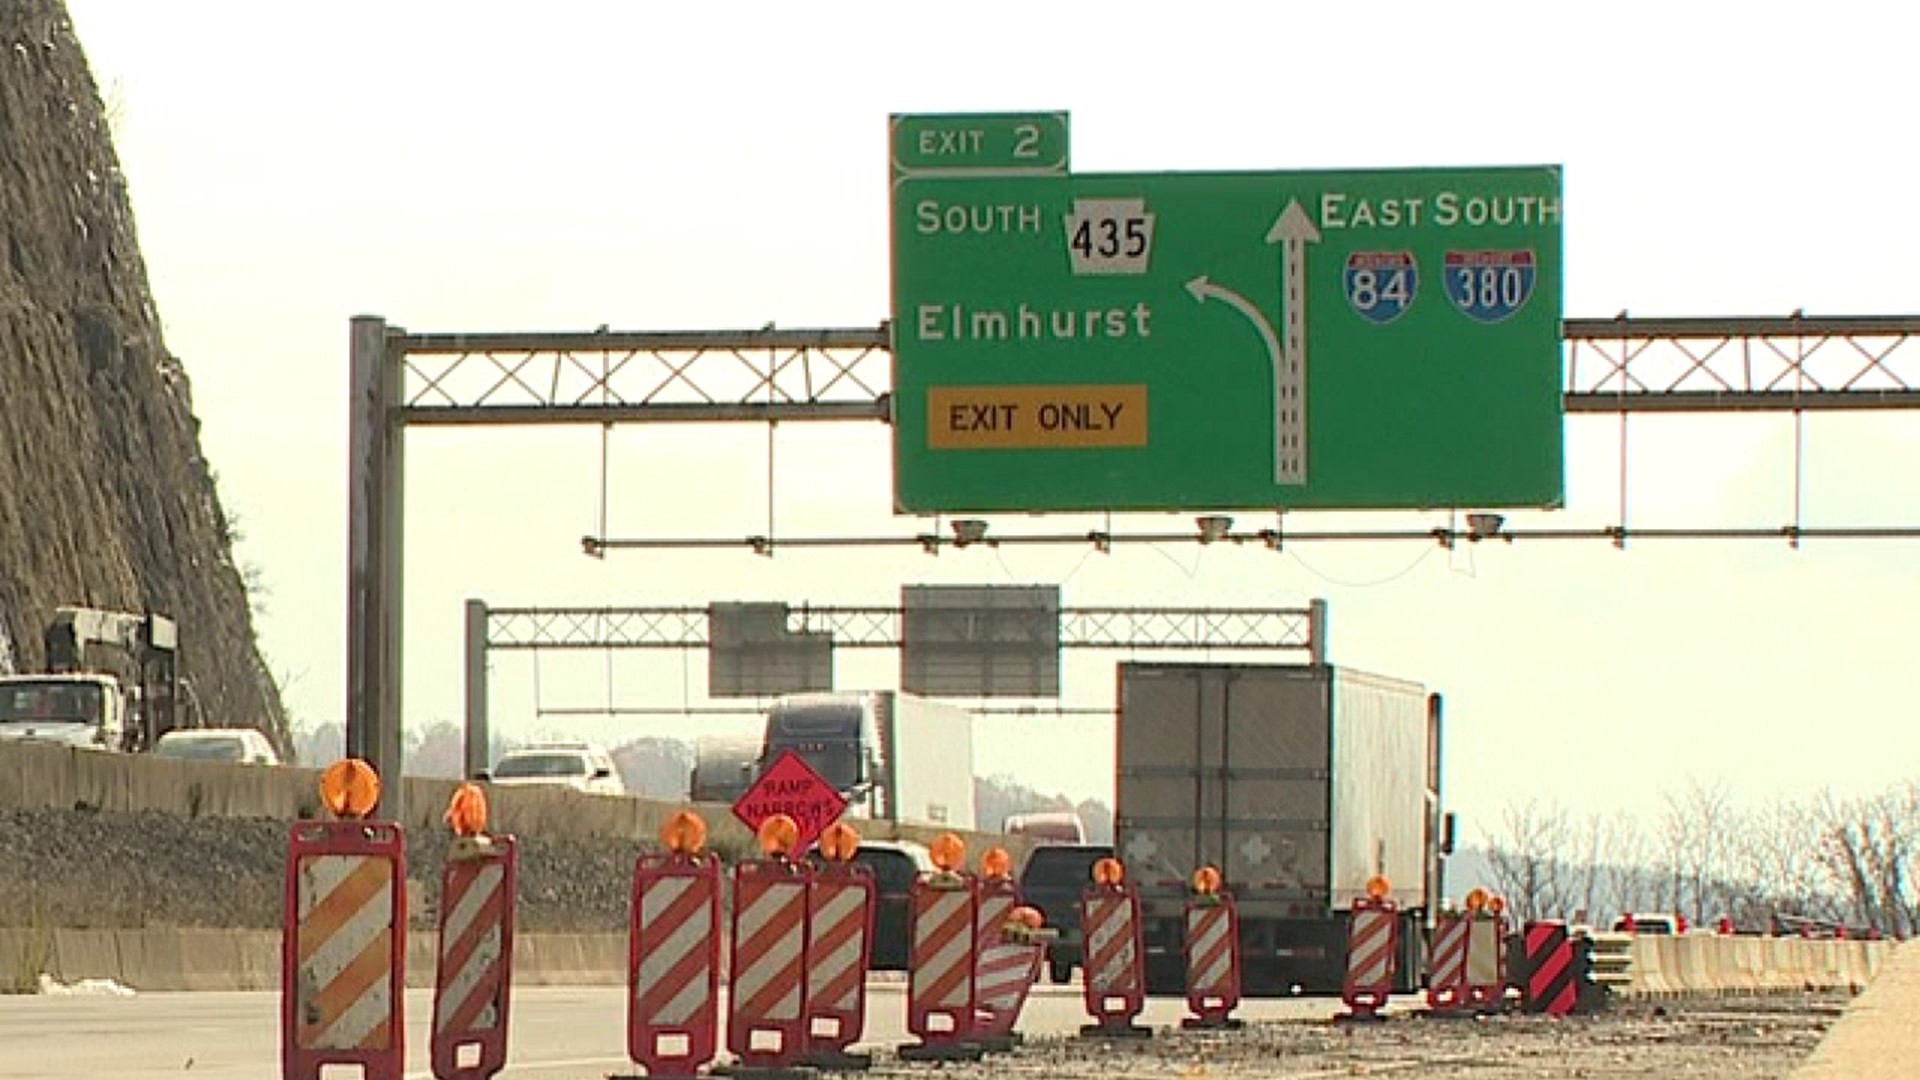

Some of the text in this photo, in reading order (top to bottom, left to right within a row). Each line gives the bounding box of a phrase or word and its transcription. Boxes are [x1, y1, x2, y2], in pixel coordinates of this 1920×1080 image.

[918, 124, 1039, 157] EXIT 2
[916, 200, 1041, 234] SOUTH
[1320, 191, 1561, 228] EAST SOUTH
[1071, 218, 1147, 259] 435
[1351, 268, 1410, 310] 84
[1457, 267, 1523, 308] 380
[918, 302, 1152, 340] Elmhurst
[949, 403, 1123, 431] EXIT ONLY
[763, 780, 814, 796] RAMP
